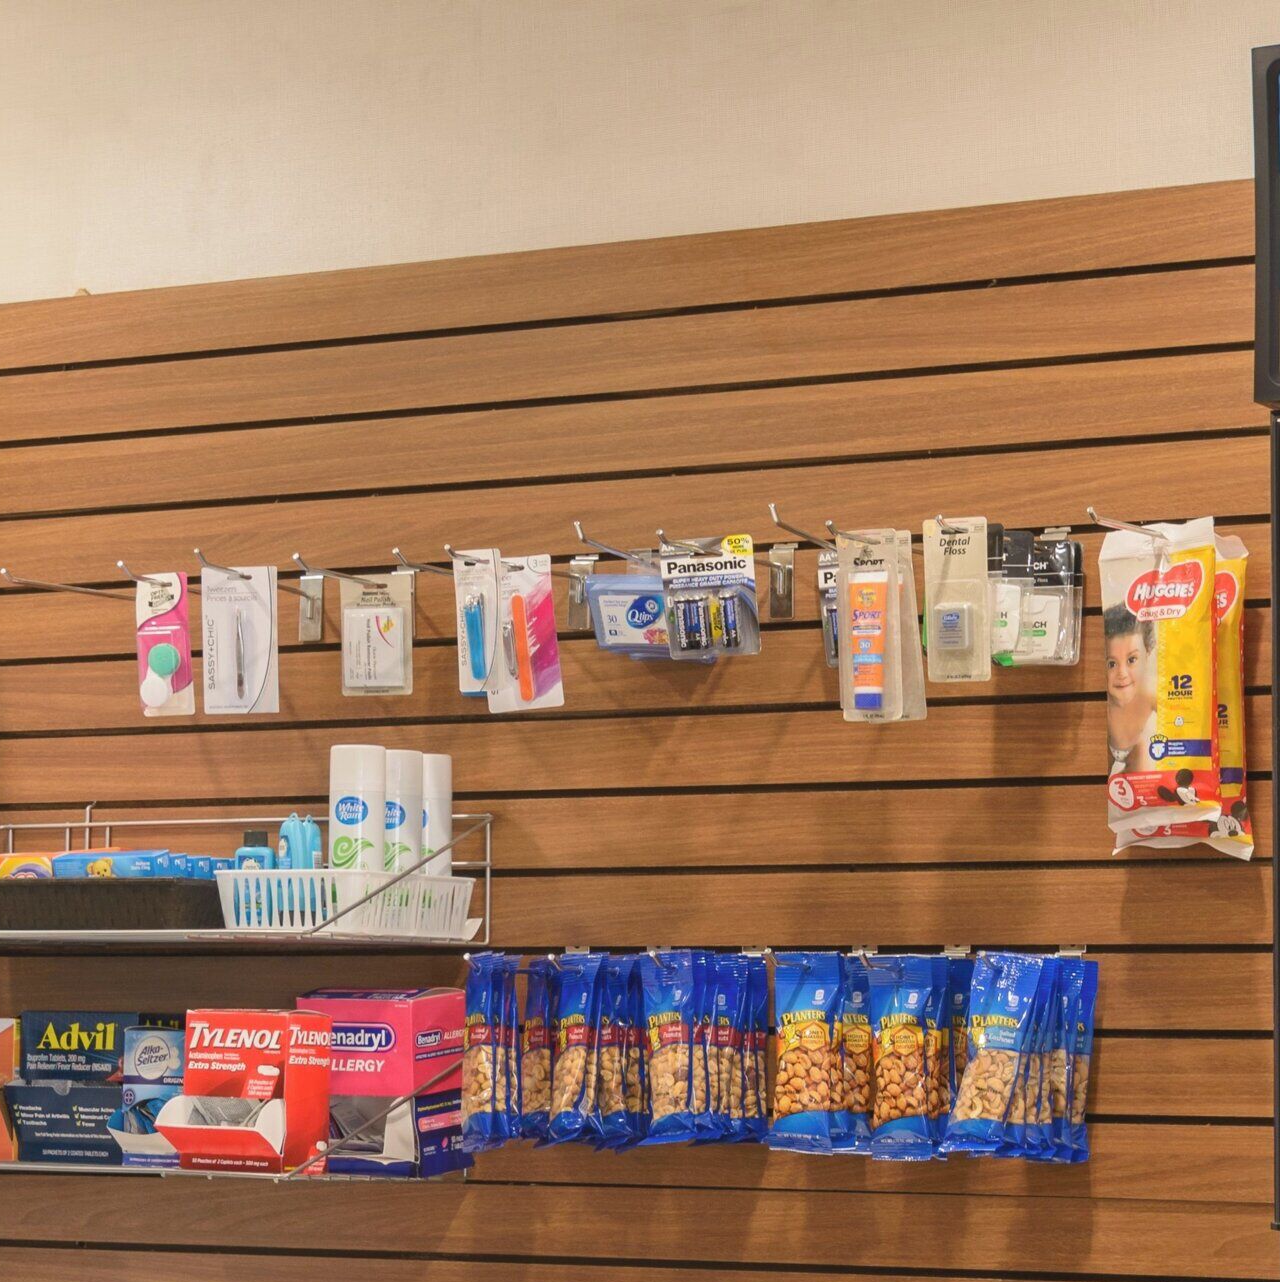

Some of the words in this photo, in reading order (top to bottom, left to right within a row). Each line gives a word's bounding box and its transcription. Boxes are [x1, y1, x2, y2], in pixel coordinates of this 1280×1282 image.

[727, 537, 749, 546] 50%
[939, 537, 970, 546] Dental
[943, 547, 966, 555] Floss
[667, 557, 746, 574] Panasonic
[1134, 582, 1194, 601] HUGGIES
[852, 610, 882, 621] SPORT
[1139, 608, 1158, 619] Snug
[1166, 607, 1181, 618] Dry
[1171, 674, 1193, 689] 12
[1114, 781, 1126, 796] 3
[338, 802, 363, 812] White
[340, 811, 362, 820] Rain
[648, 1012, 681, 1027] PLANTERS
[783, 1010, 826, 1025] PLANTERS
[881, 1013, 917, 1029] PLANTERS
[972, 1014, 1018, 1028] PLANTERS
[36, 1022, 116, 1050] Advil
[189, 1023, 281, 1049] TYLENOL
[290, 1026, 331, 1046] TYLENO
[331, 1030, 385, 1051] enadryl
[417, 1033, 440, 1044] Benadryl
[141, 1046, 163, 1055] Alka-
[137, 1054, 167, 1066] Seltzer
[188, 1061, 208, 1070] Extra
[210, 1062, 245, 1072] Strength
[289, 1056, 306, 1065] Extra
[331, 1059, 385, 1072] LLERGY
